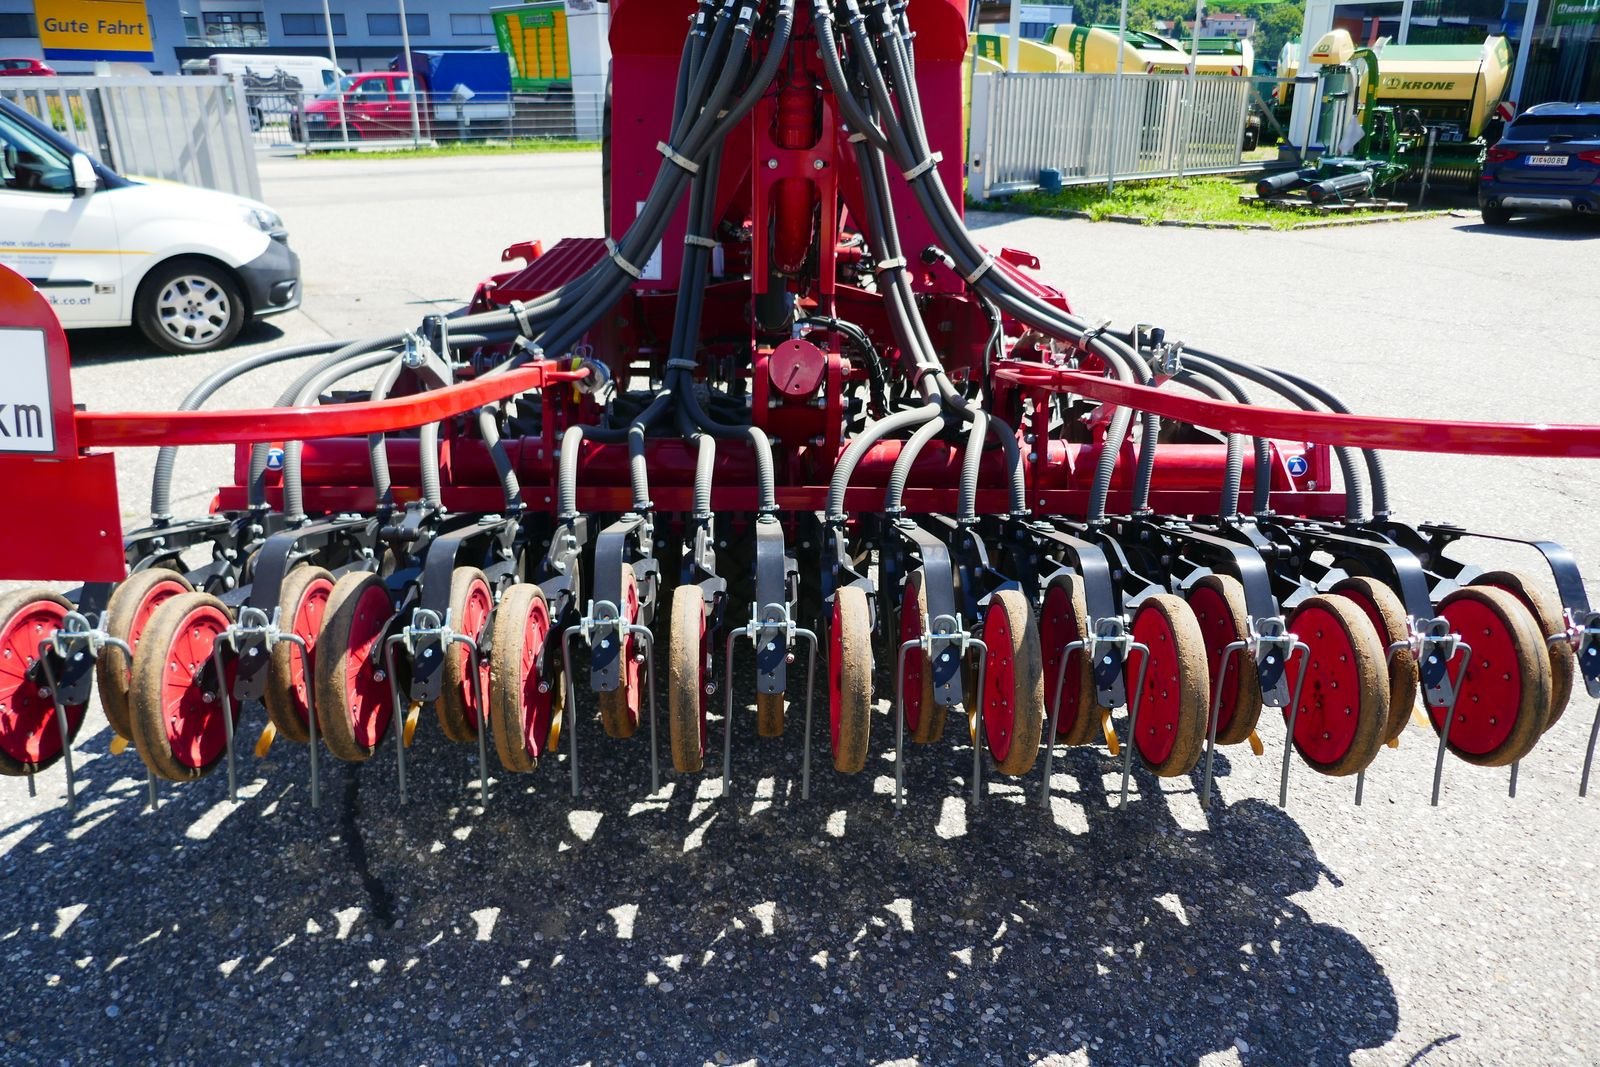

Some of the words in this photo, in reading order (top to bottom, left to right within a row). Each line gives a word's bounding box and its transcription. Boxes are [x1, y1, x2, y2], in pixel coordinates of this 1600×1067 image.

[44, 17, 89, 33] Gute
[97, 20, 145, 35] Fahrt
[1401, 81, 1456, 90] KRONE
[49, 296, 91, 305] ik.co.at
